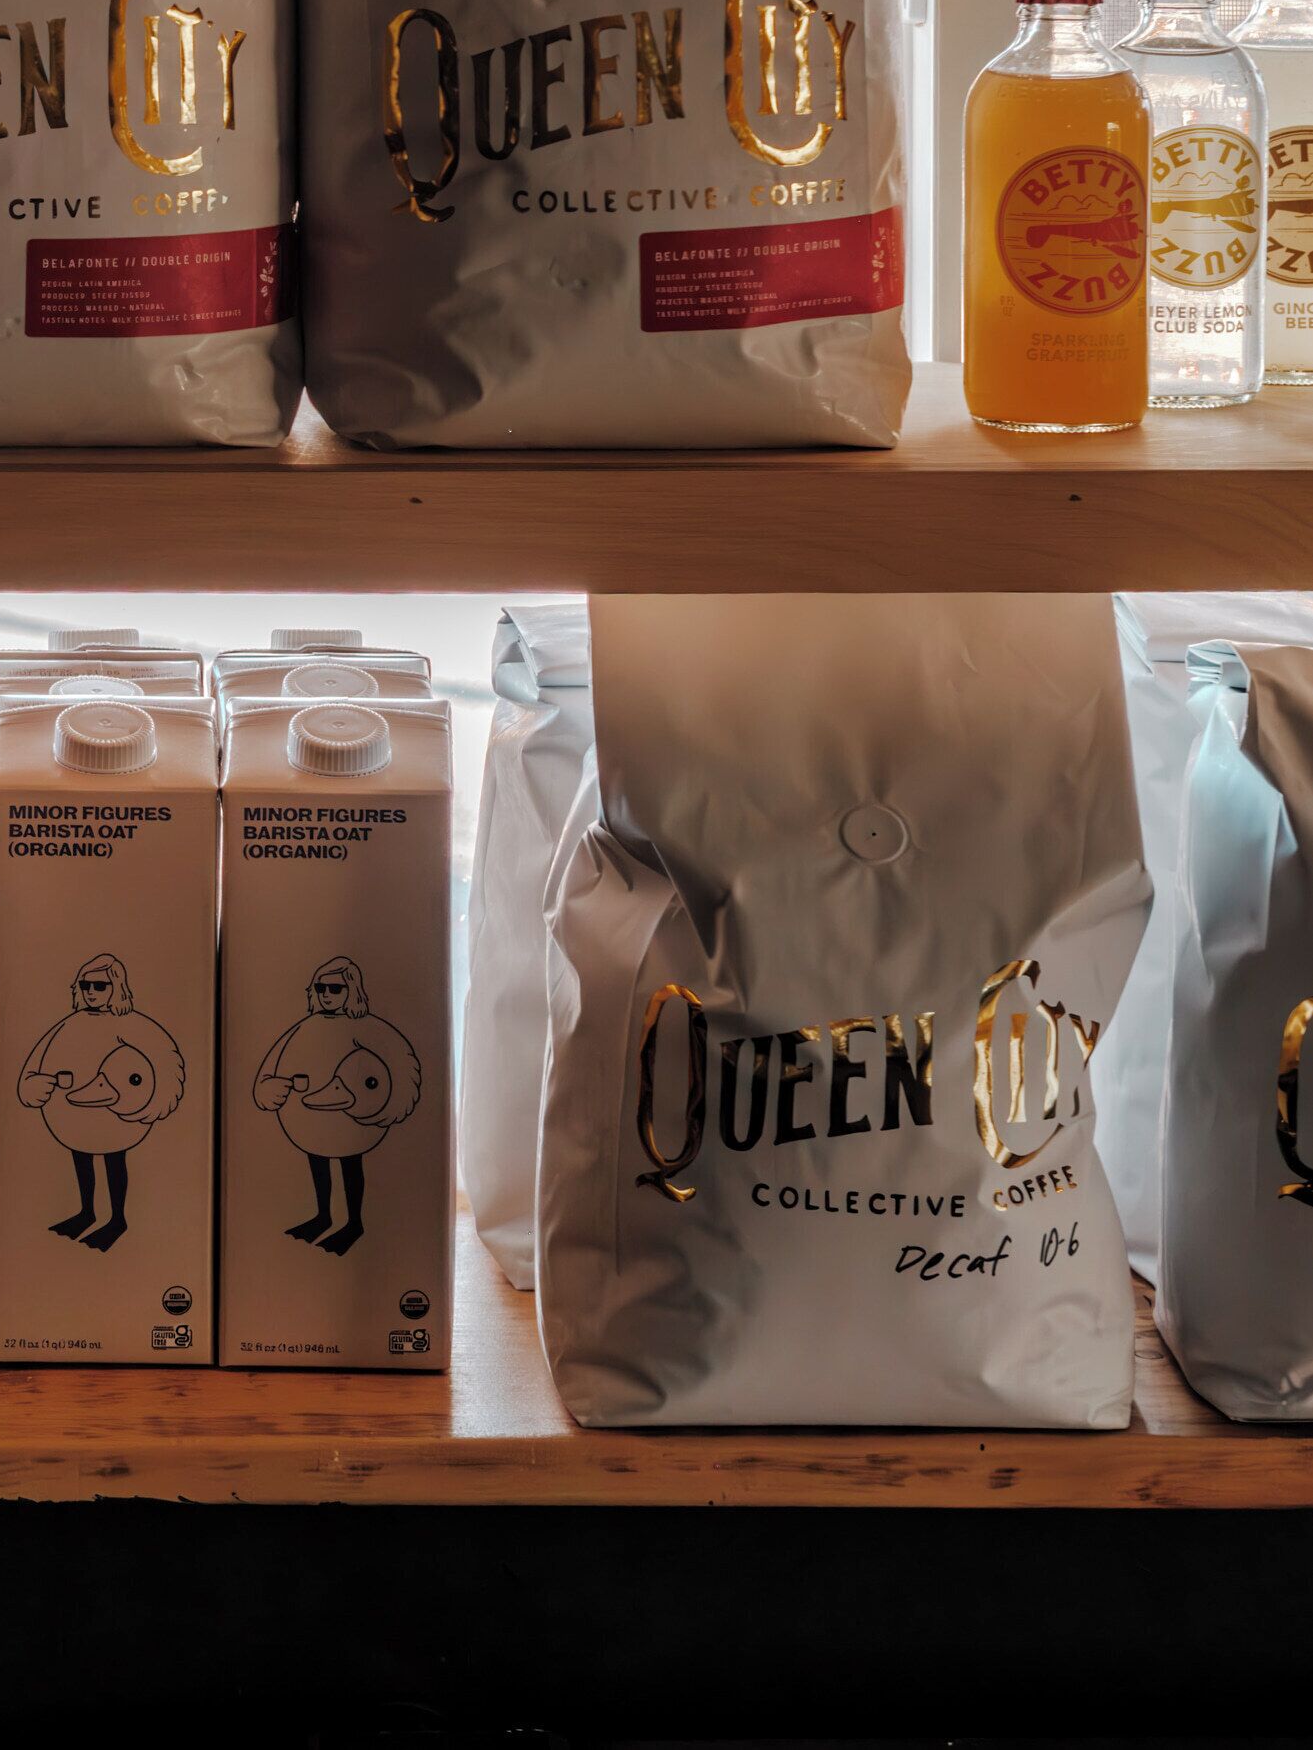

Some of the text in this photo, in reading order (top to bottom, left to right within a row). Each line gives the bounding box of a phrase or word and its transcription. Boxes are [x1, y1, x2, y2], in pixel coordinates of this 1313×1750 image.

[384, 8, 686, 224] QUEEN
[1019, 158, 1137, 207] BETTY
[131, 187, 231, 216] COFFE
[511, 179, 847, 214] COLLECTIVE COFFEE
[42, 257, 119, 270] BELAFONTE
[141, 254, 190, 267] DOUBLE
[195, 251, 231, 264] ORIGIN
[655, 249, 731, 262] BELAFONTE
[754, 243, 799, 256] DOUBLE
[1026, 261, 1131, 303] BUZZ
[1154, 320, 1245, 333] CLUB SODA
[9, 805, 172, 821] MINOR FIGURES
[243, 807, 407, 823] MINOR FIGURES
[8, 824, 138, 839] BARISTA OAT
[243, 826, 373, 841] BARISTA OAT
[8, 841, 113, 858] (ORGANIC)
[243, 844, 348, 860] (ORGANIC)
[635, 959, 1101, 1203] QUEEN CITY
[751, 1165, 1078, 1218] COLLECTIVE COFFEE
[894, 1235, 1012, 1281] Decaf
